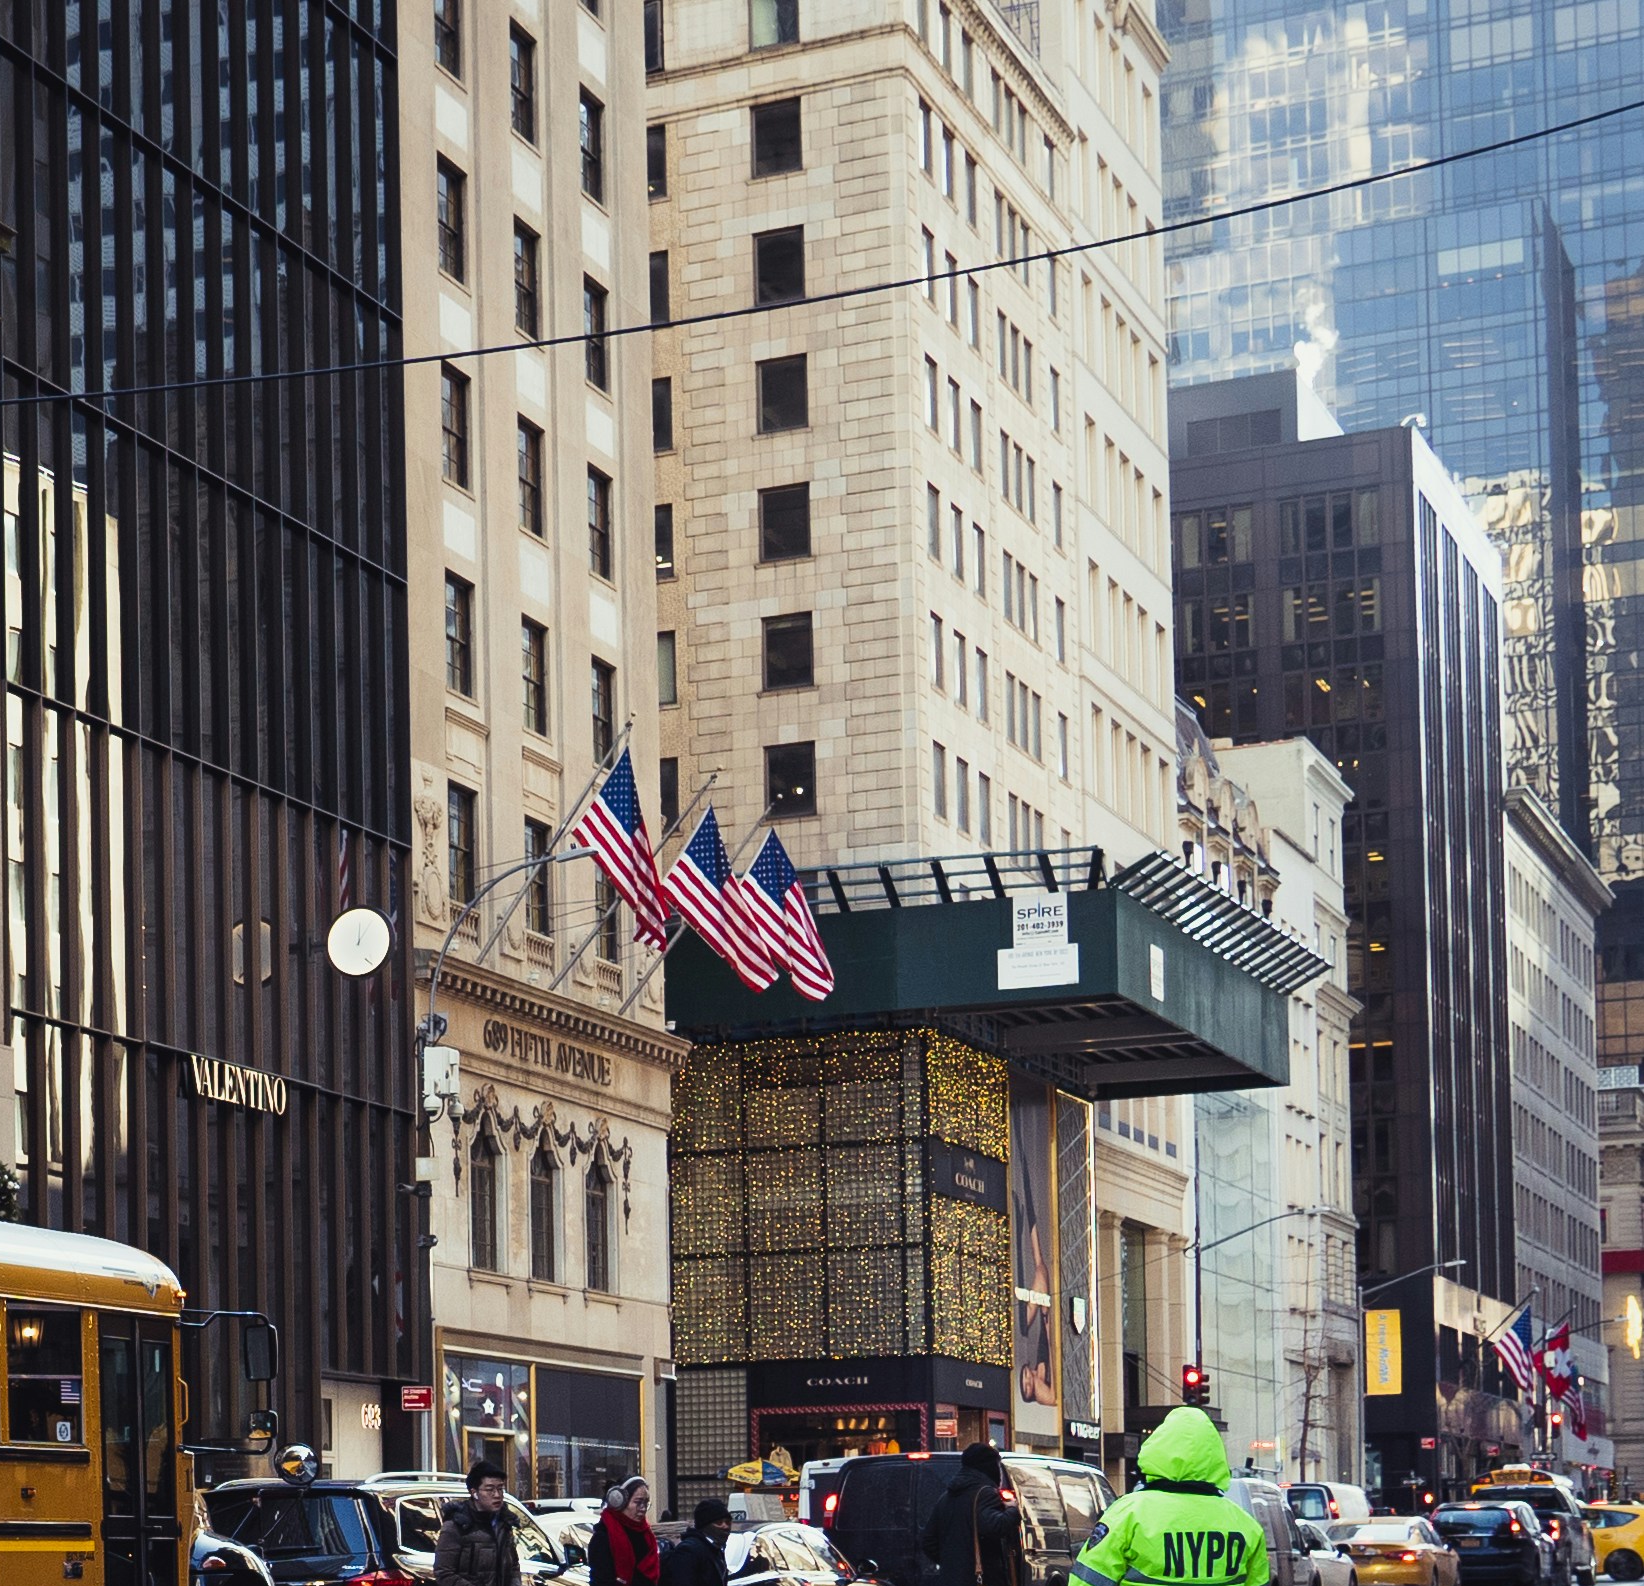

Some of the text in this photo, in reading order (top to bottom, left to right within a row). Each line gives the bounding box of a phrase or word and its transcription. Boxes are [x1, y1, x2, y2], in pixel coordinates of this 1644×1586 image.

[1017, 898, 1063, 919] SPIRE
[483, 1019, 612, 1087] 689 FIFTH AVENUE
[191, 1055, 286, 1115] VALENTINO
[955, 1172, 985, 1194] COACH
[806, 1376, 869, 1387] COACH
[361, 1403, 382, 1430] 693
[1163, 1531, 1246, 1578] NYPD
